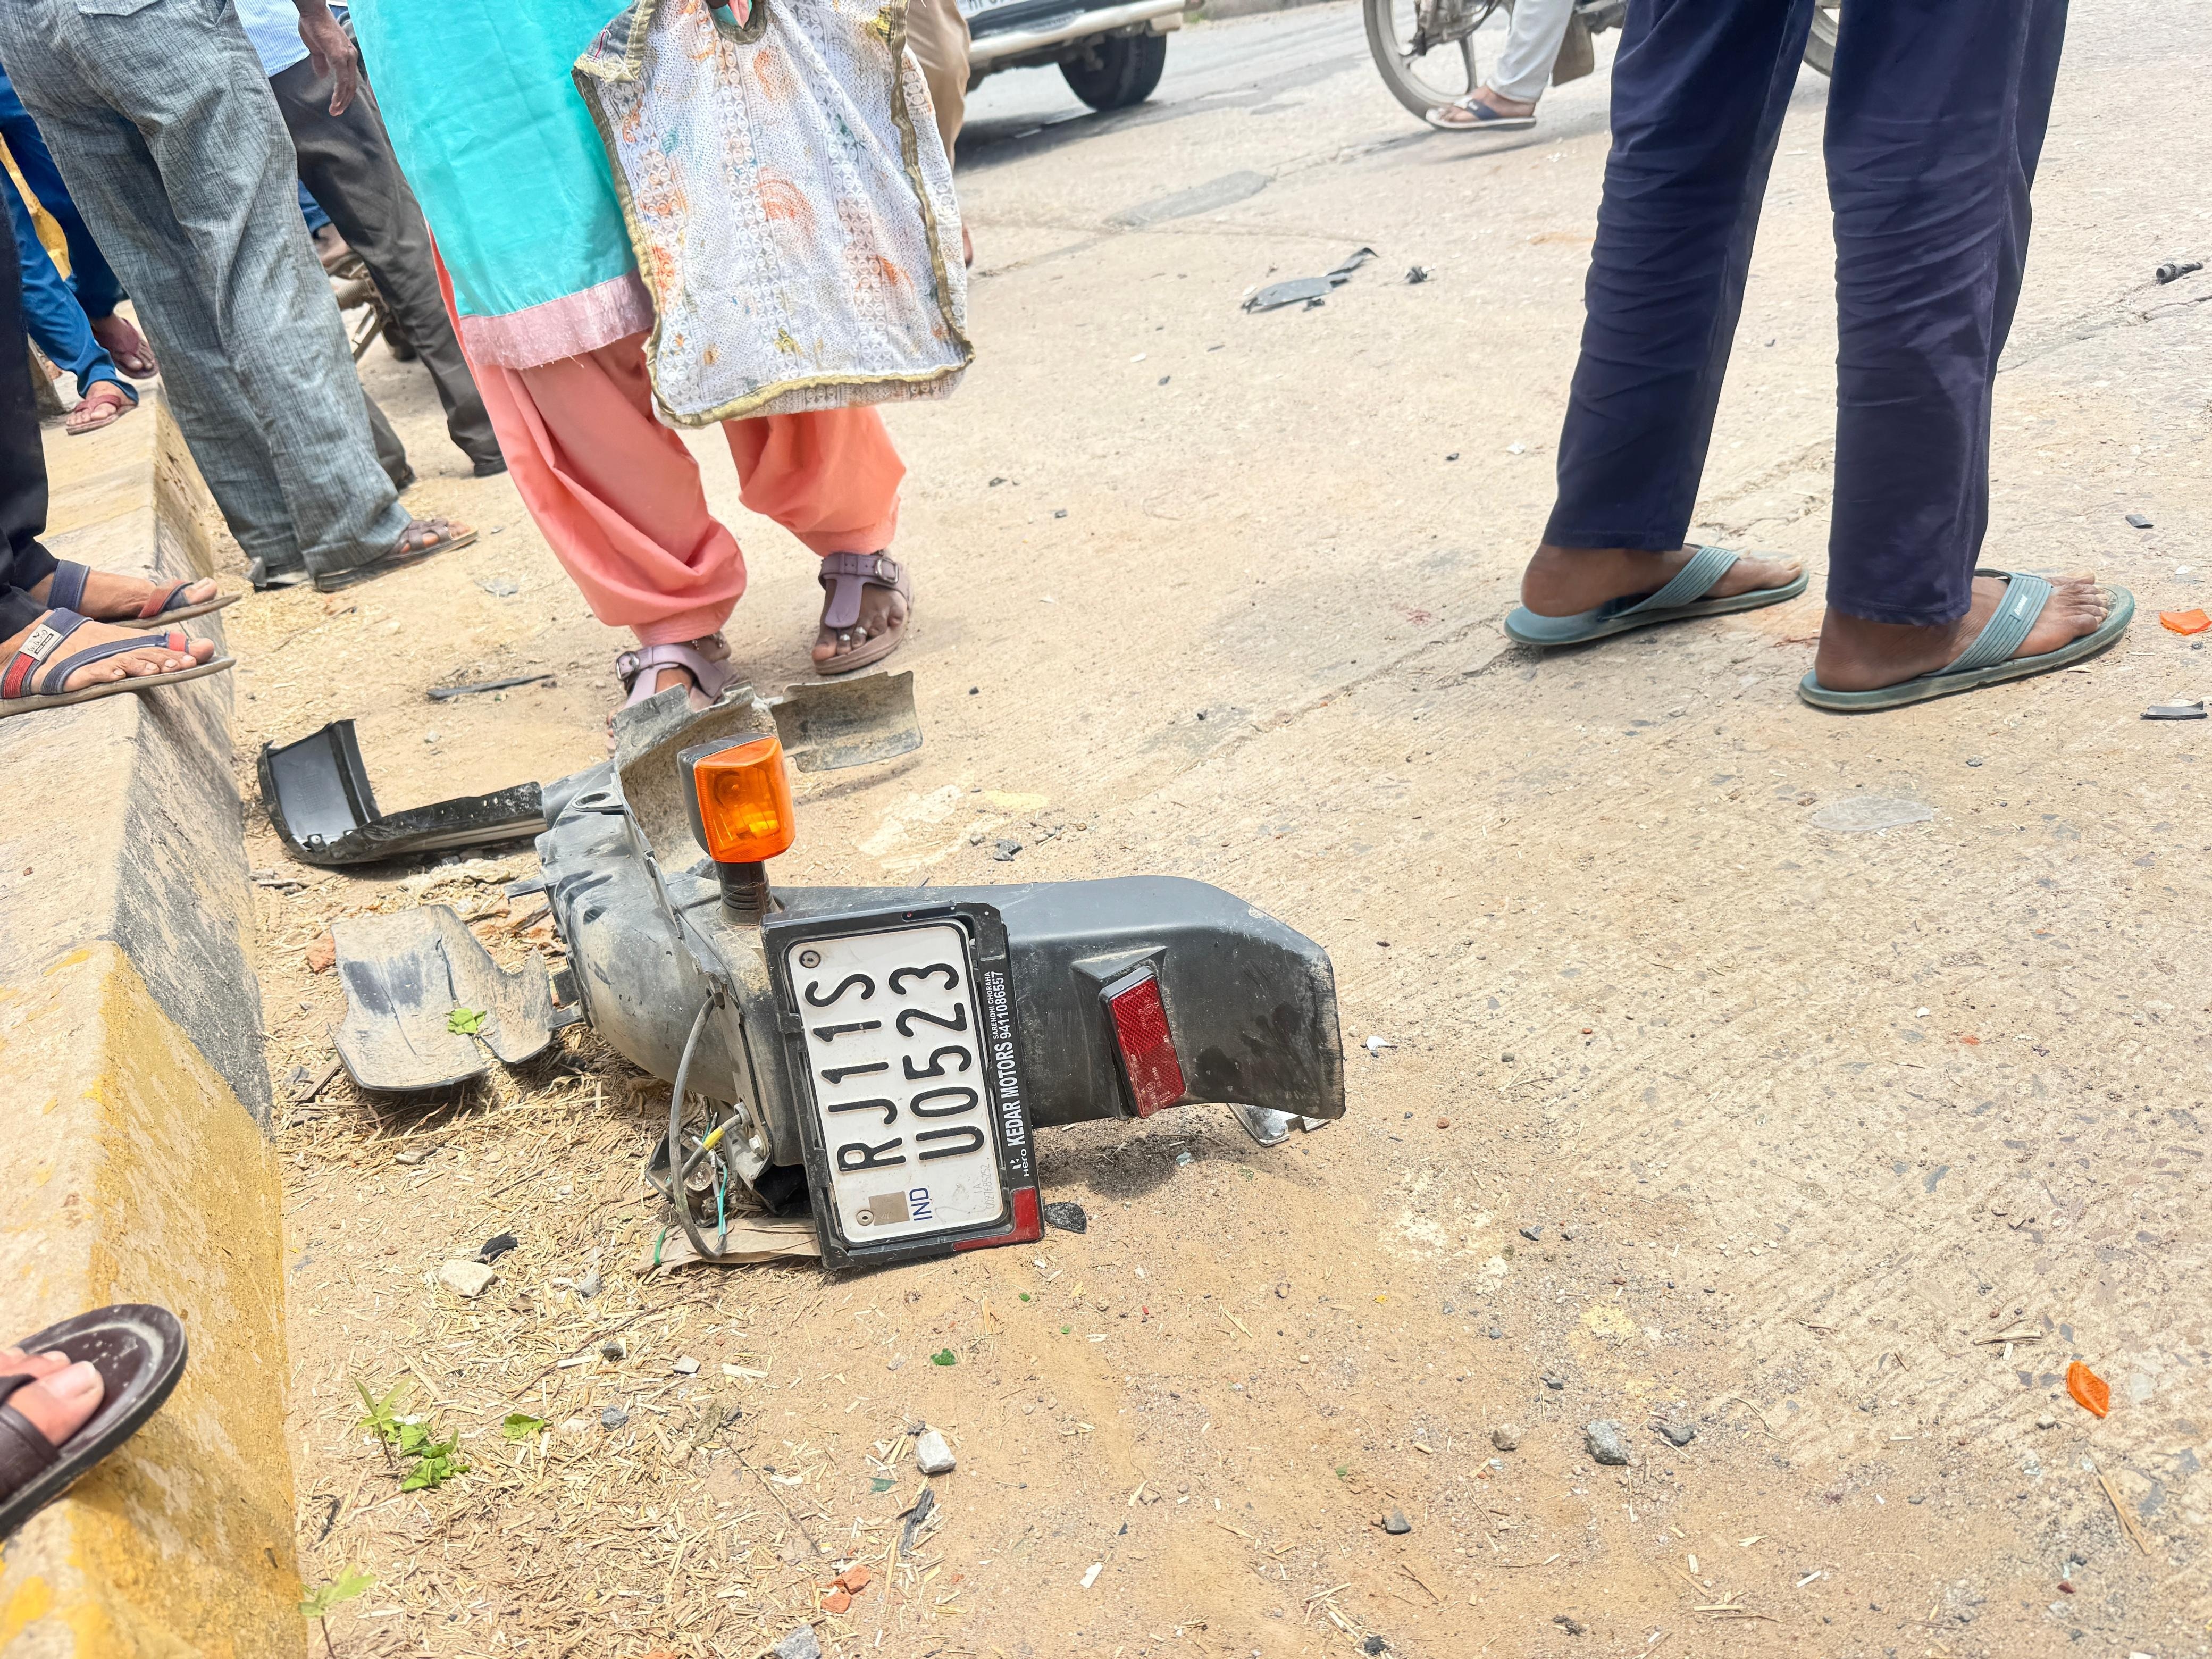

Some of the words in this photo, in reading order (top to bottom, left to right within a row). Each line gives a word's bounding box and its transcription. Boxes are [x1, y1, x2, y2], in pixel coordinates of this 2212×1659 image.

[984, 971, 994, 1004] CHORAHA
[991, 971, 1011, 1040] 9411086557
[988, 1006, 999, 1040] SARENDHI
[805, 974, 907, 1172] RJ11S
[888, 963, 985, 1161] U0523
[994, 1042, 1019, 1099] MOTORS
[1002, 1100, 1026, 1147] KEDAR
[909, 1188, 933, 1221] IND
